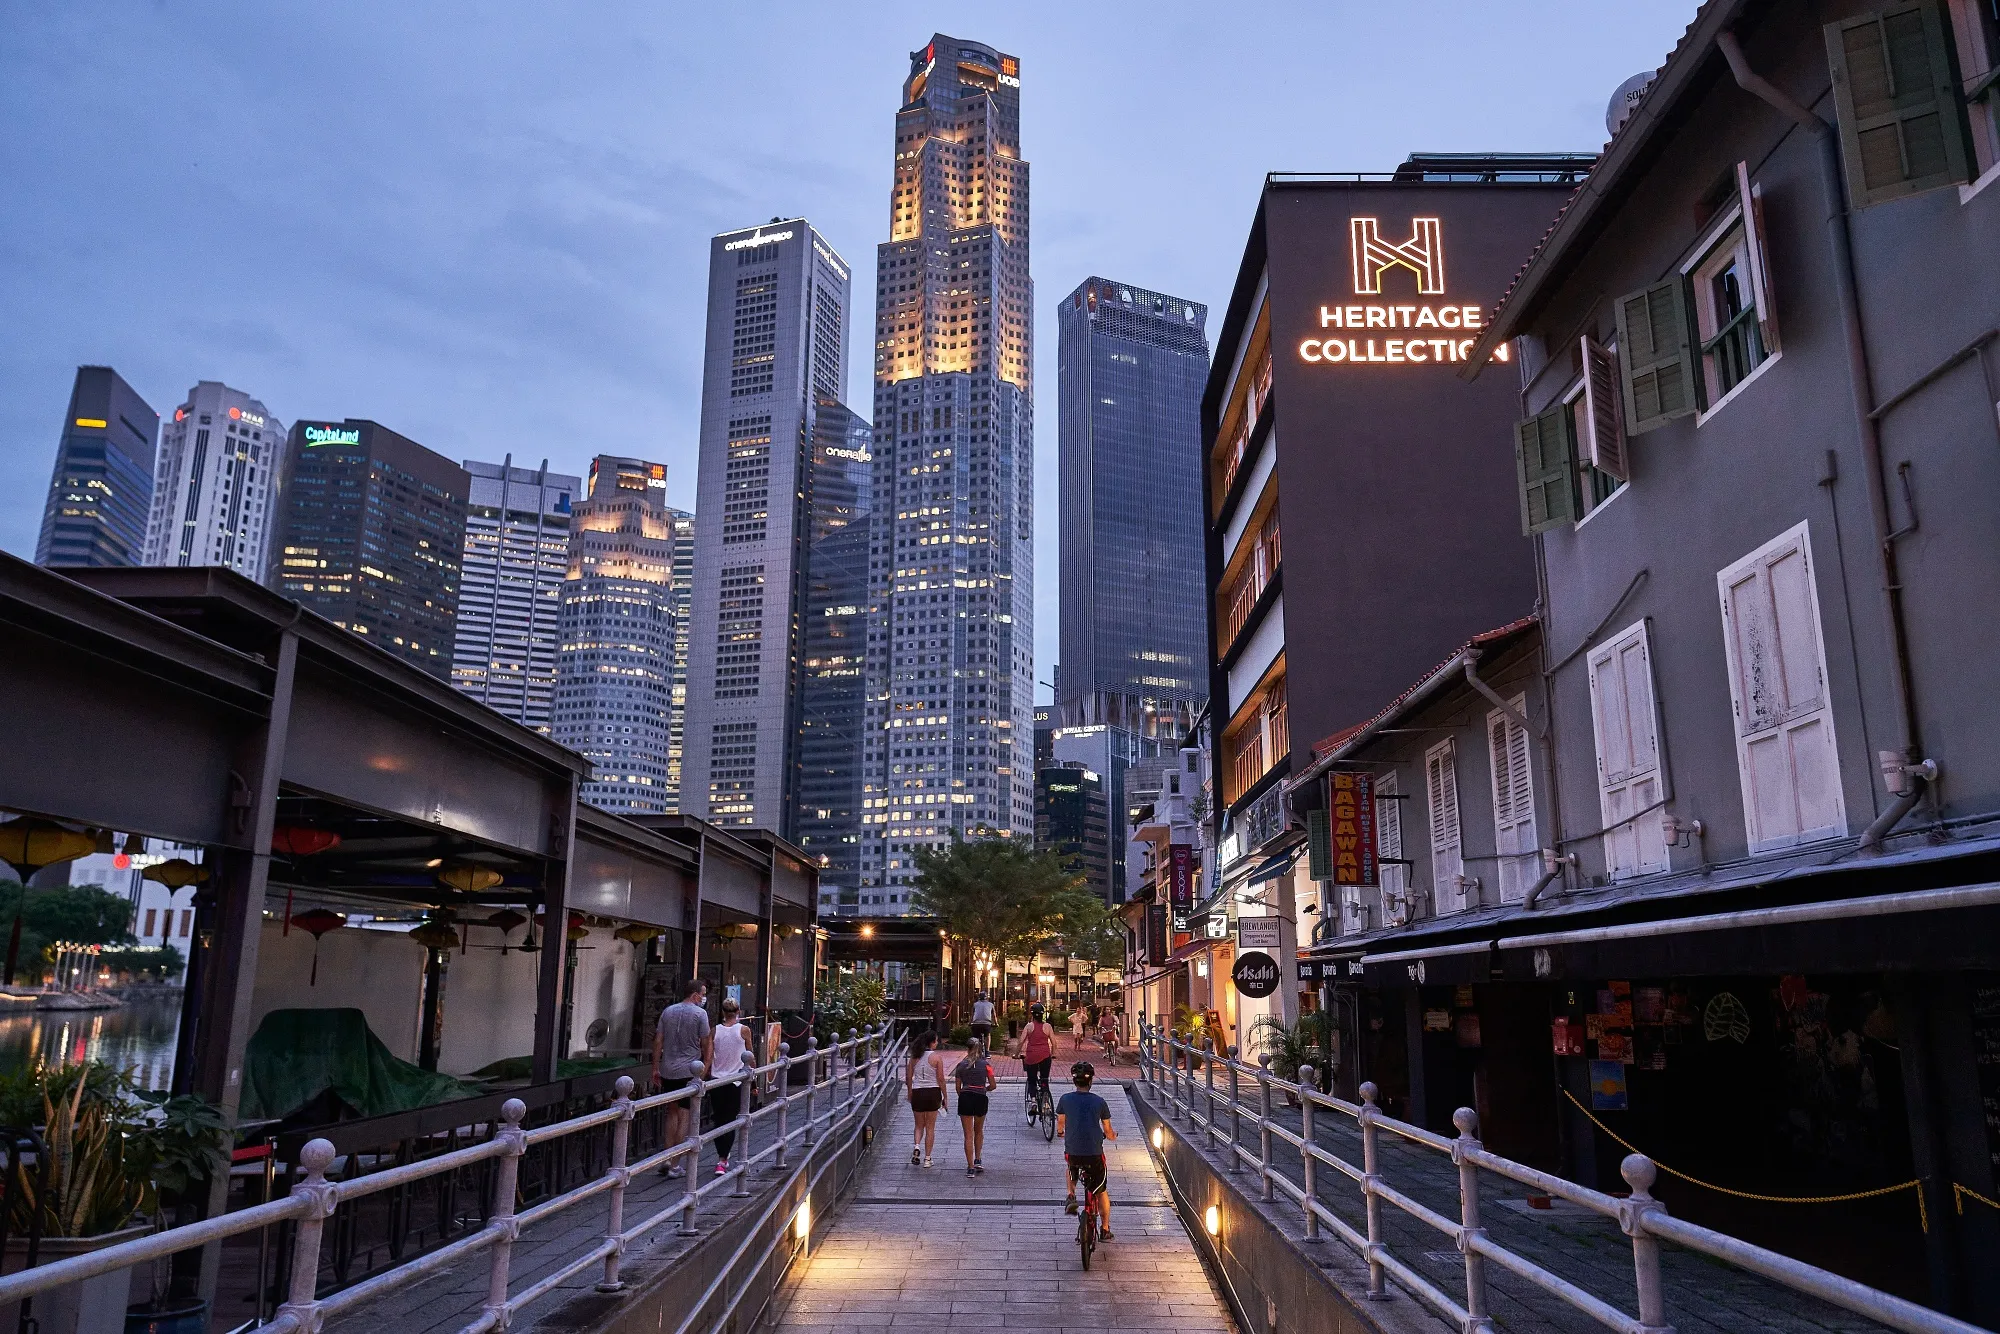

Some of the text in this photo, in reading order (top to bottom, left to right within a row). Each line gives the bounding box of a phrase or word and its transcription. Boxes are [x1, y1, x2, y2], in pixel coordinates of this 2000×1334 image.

[997, 73, 1020, 88] UOB
[1626, 87, 1648, 102] SOU
[1320, 306, 1481, 328] HERITAGE
[305, 425, 360, 443] CapitaLand
[647, 478, 666, 489] UOB
[1334, 775, 1358, 882] BAGAWAN
[1241, 921, 1279, 931] BREWLANDER
[1237, 964, 1274, 980] Asahi
